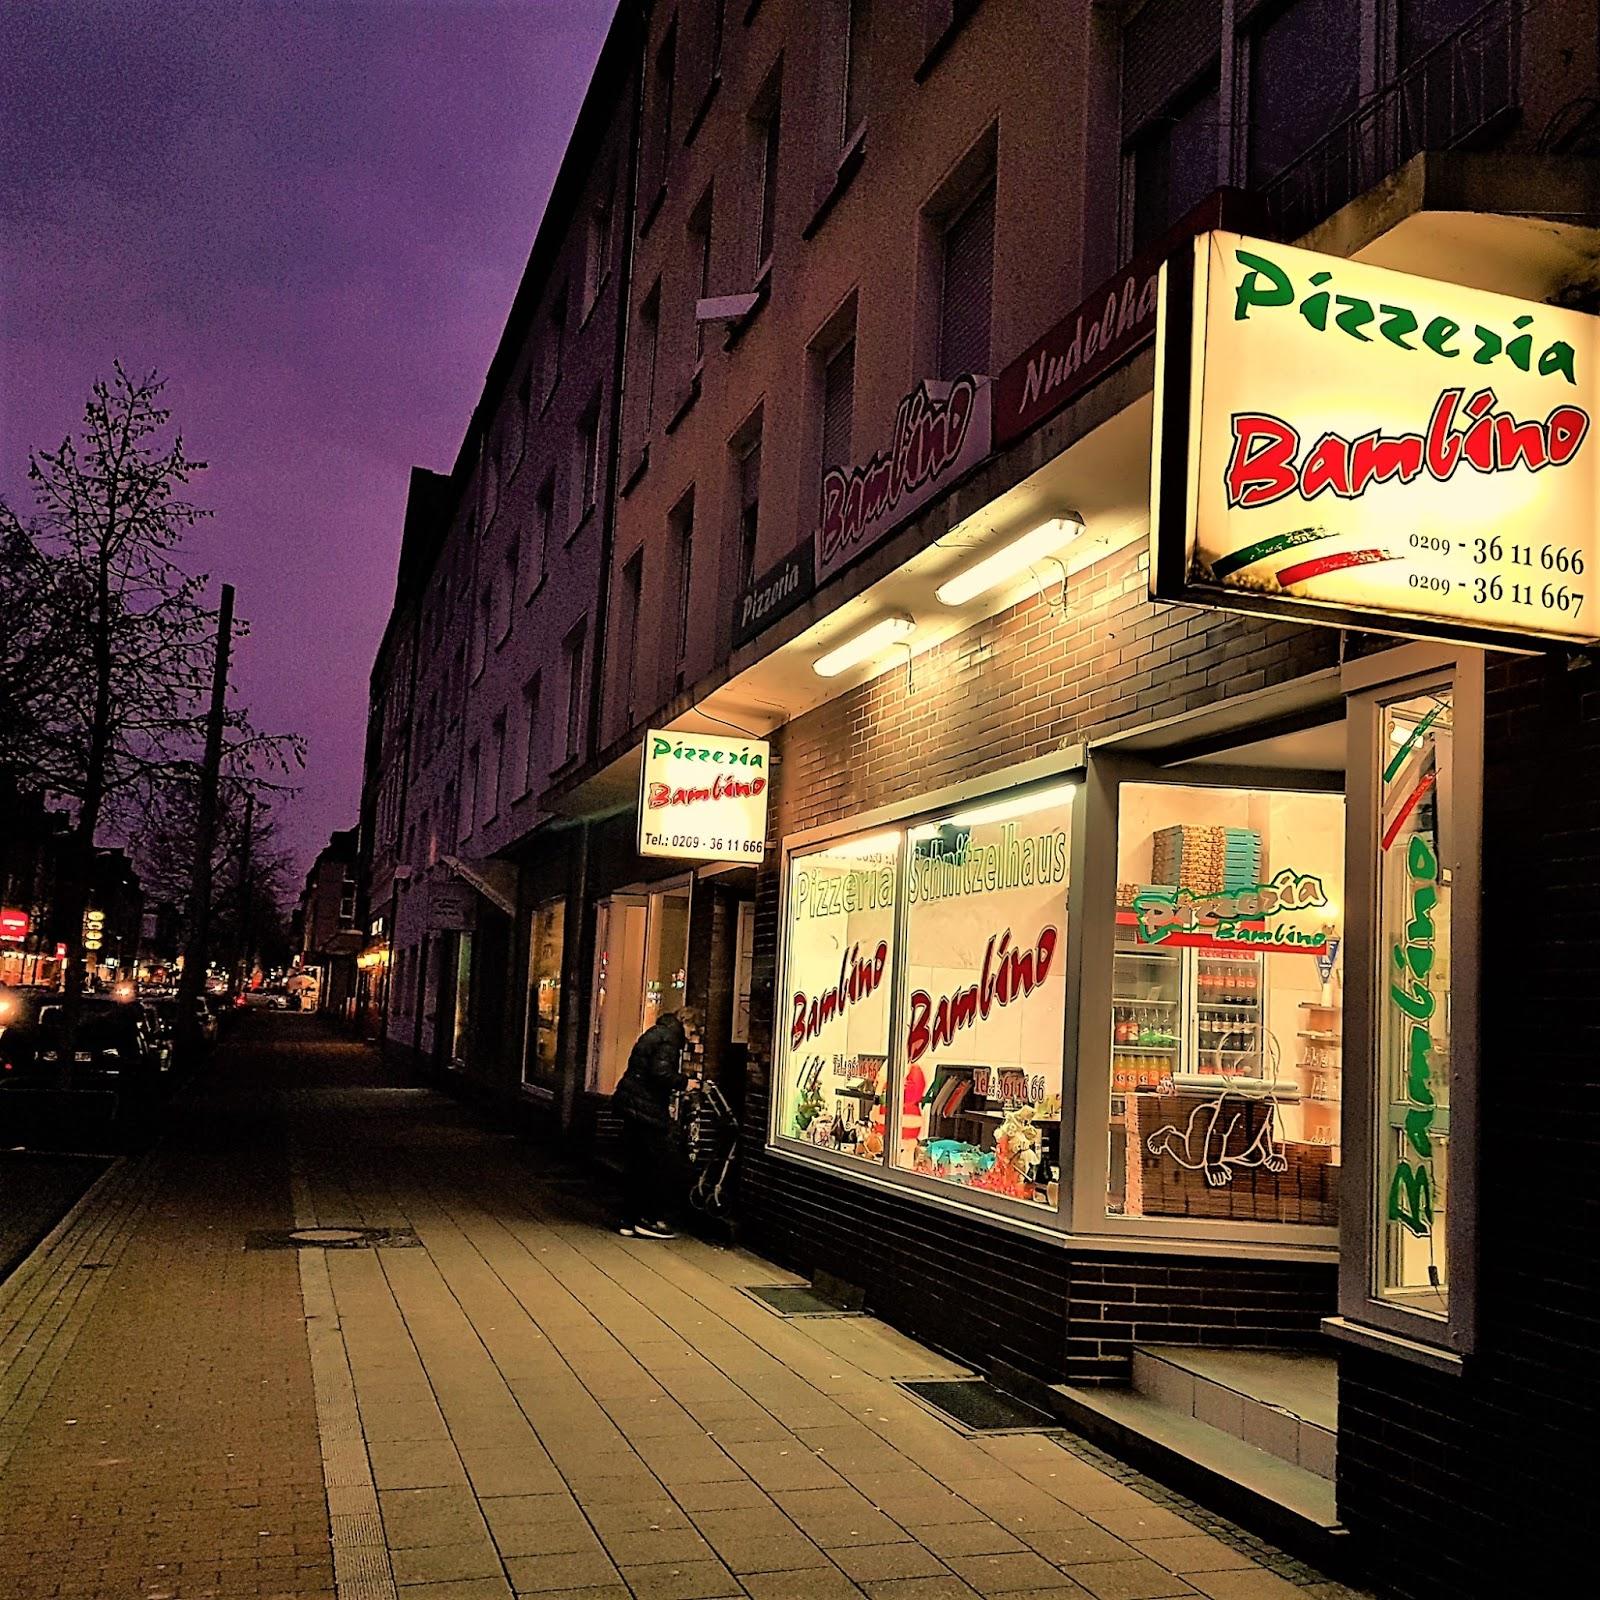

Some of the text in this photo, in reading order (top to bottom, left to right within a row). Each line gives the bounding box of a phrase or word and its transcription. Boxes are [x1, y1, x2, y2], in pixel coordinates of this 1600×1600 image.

[1234, 249, 1577, 386] Pizzeria
[821, 371, 977, 565] Bambino
[1224, 386, 1590, 510] Bambino
[1409, 533, 1451, 556] 0209
[1473, 535, 1503, 564] 36
[1511, 544, 1533, 566] 11
[1540, 544, 1584, 575] 666
[741, 562, 799, 628] Pizzeria
[1408, 573, 1451, 596] 0209
[1473, 574, 1503, 604] 36
[1511, 583, 1533, 606] 11
[1541, 583, 1584, 619] 667
[652, 737, 763, 768] Pizzeria
[647, 773, 767, 810] Bambino
[645, 832, 669, 847] Tel.:
[671, 835, 699, 848] 0209
[709, 837, 723, 850] 36
[727, 839, 739, 851] 11
[742, 840, 763, 853] 666
[909, 821, 1067, 904] Schnitzelhaus
[794, 866, 894, 921] Pizzeria
[1216, 921, 1326, 946] Bambino
[790, 939, 888, 1052] Bambino
[907, 924, 1058, 1064] Bambino
